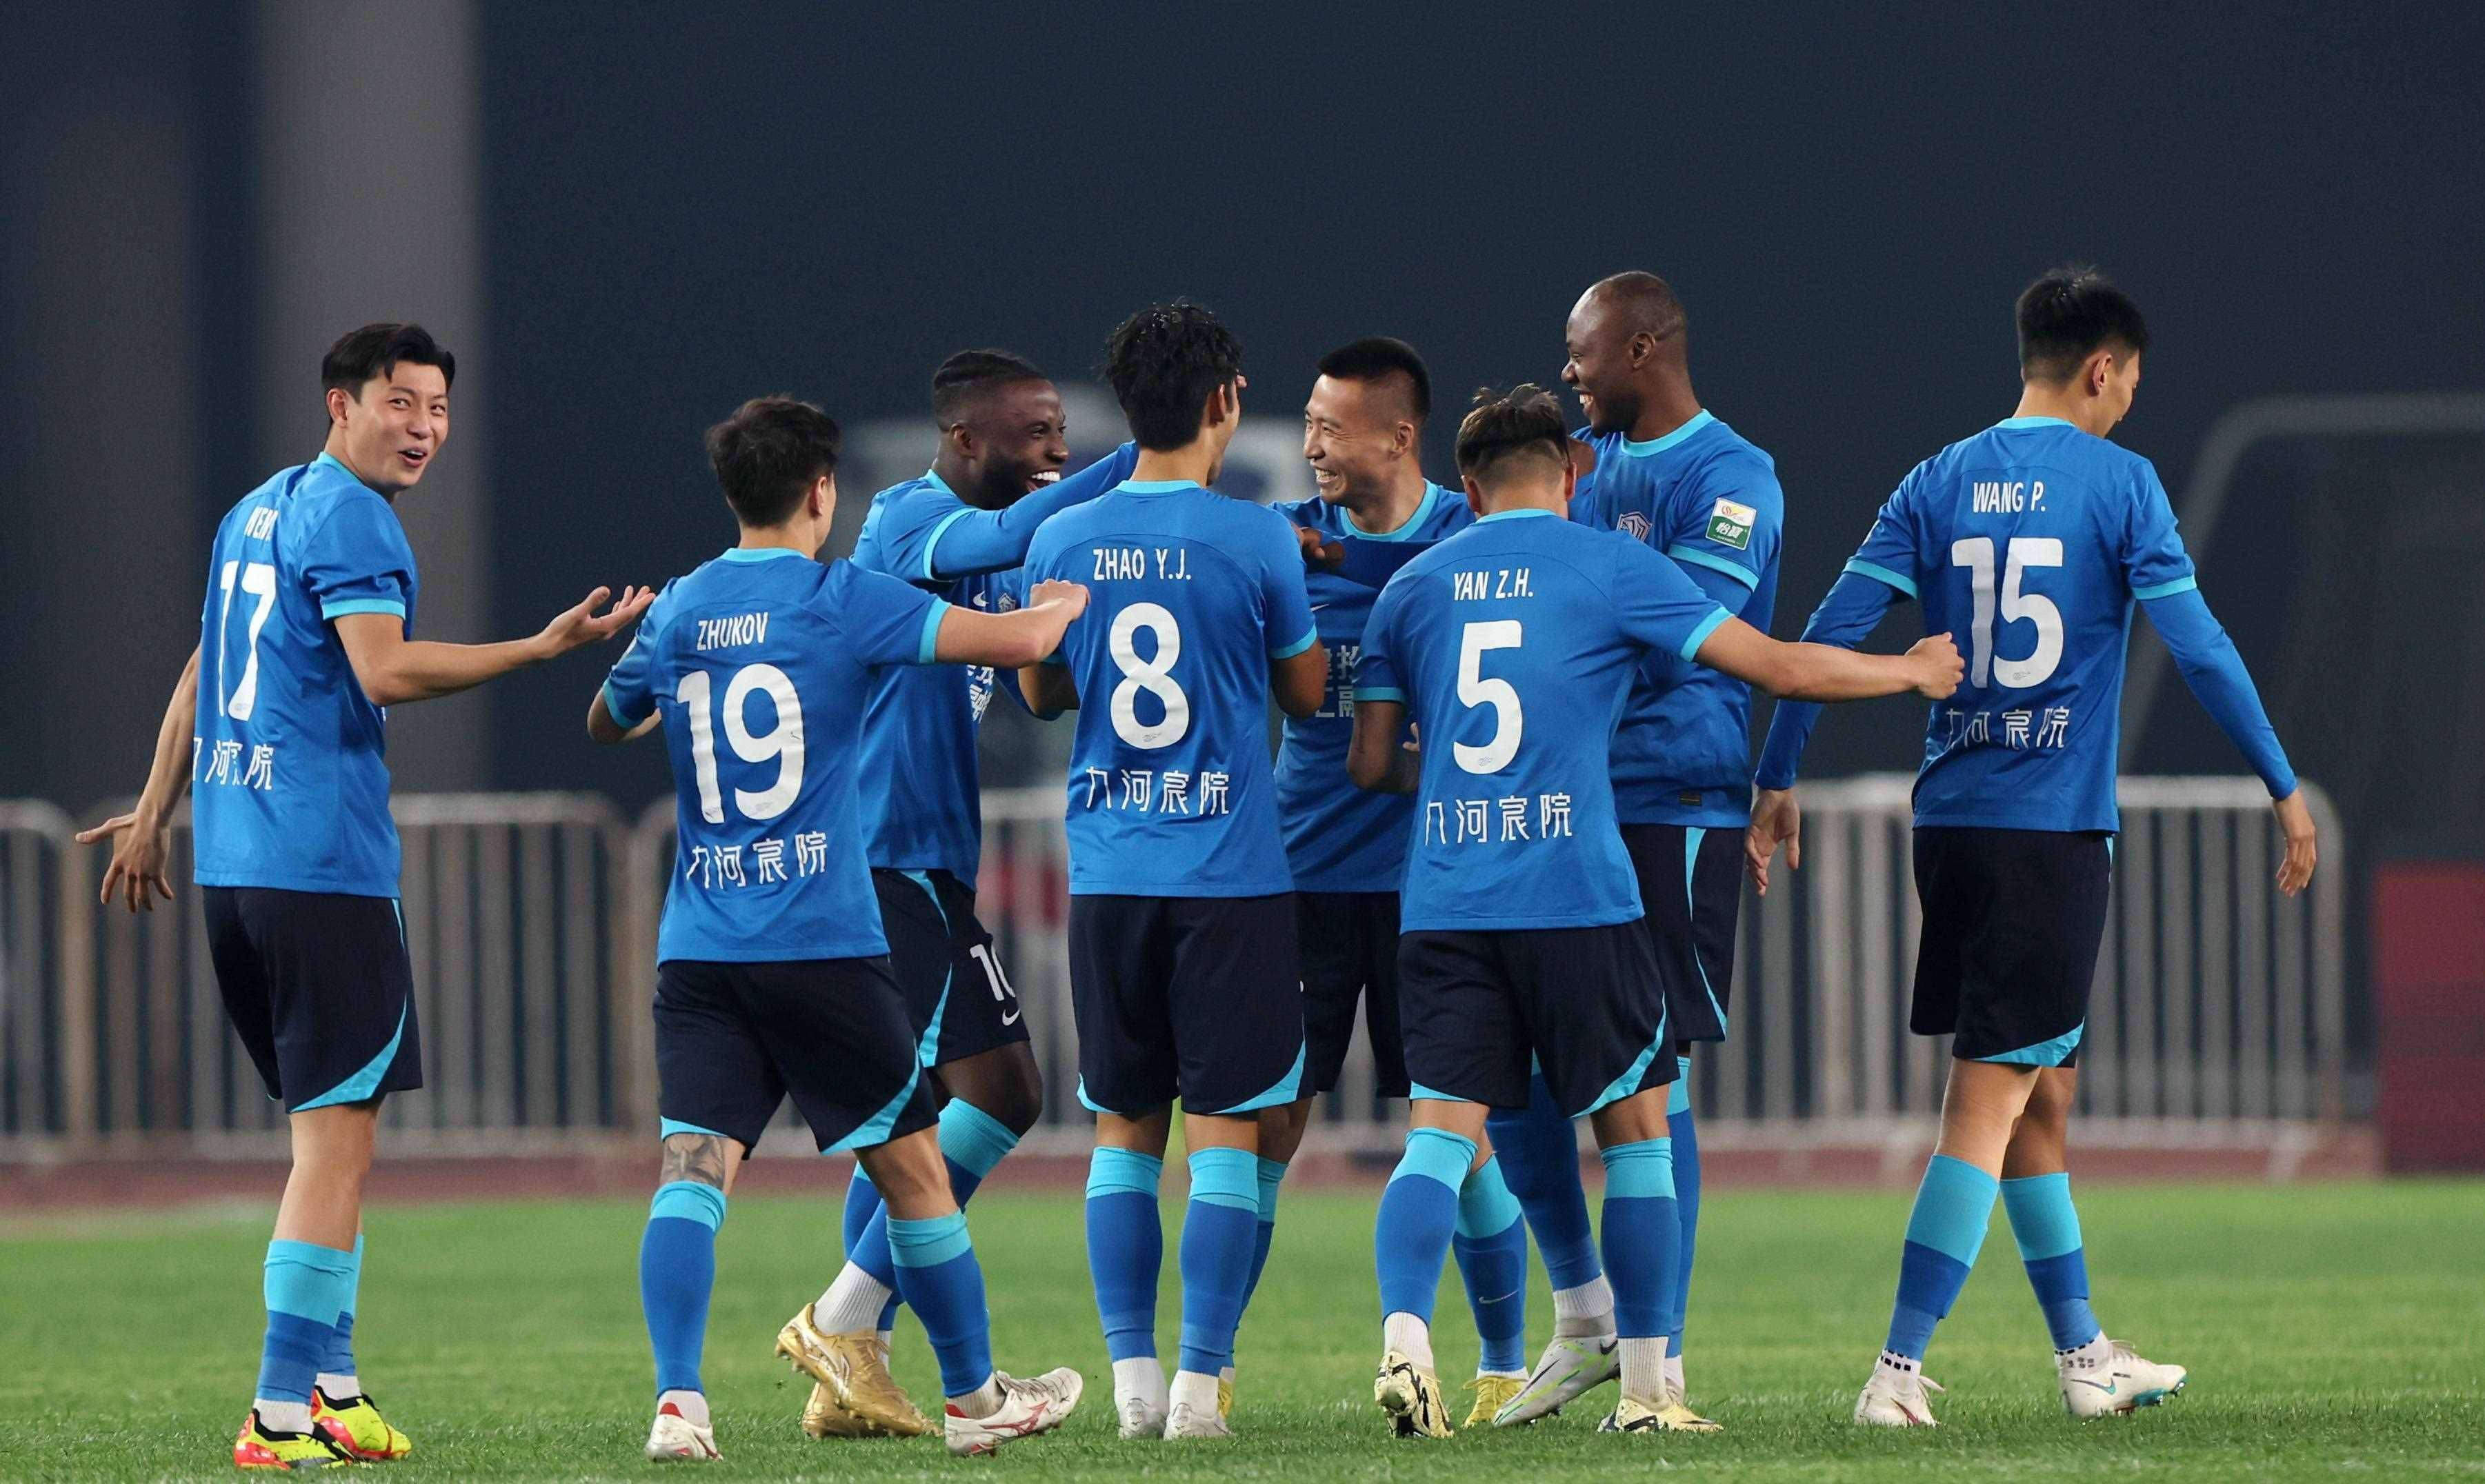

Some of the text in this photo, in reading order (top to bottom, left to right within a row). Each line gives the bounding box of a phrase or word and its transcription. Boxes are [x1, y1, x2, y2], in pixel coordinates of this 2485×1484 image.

[1092, 548, 1191, 581] ZHAO Y.J.
[1973, 481, 2046, 513] WANG P.
[218, 560, 277, 721] 17
[697, 612, 768, 651] ZHUKOV
[1454, 568, 1533, 601] YAN Z.H.
[1951, 537, 2064, 688] 15
[677, 663, 805, 823] 19
[1109, 602, 1189, 750] 8
[1453, 619, 1523, 774] 5
